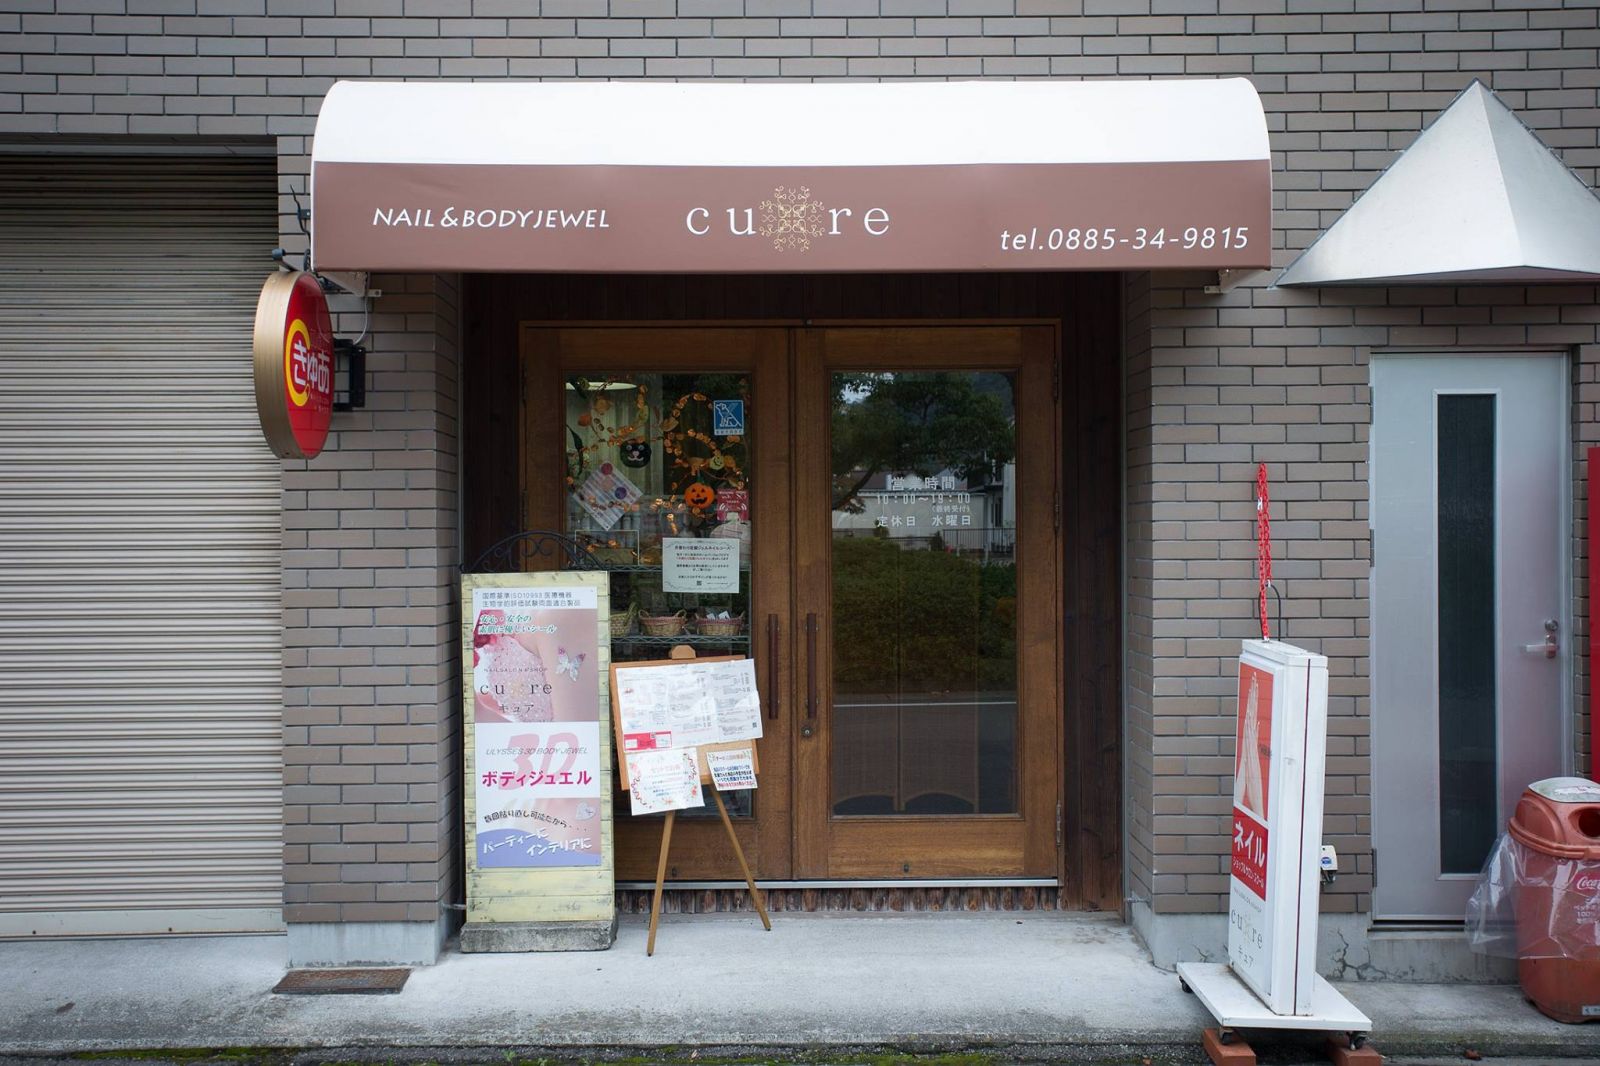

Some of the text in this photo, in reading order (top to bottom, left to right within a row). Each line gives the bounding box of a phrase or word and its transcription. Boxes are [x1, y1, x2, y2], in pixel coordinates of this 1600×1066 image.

[1000, 227, 1249, 250] tel.0885-34-9815
[293, 340, 330, 394] きゅあ
[891, 476, 956, 491] 営業時間
[876, 514, 971, 527] 定休日 水曜日
[482, 770, 592, 787] ボディジュエル
[483, 828, 549, 854] パーティーに
[526, 838, 592, 857] インテリアに
[1234, 820, 1266, 868] ネイル
